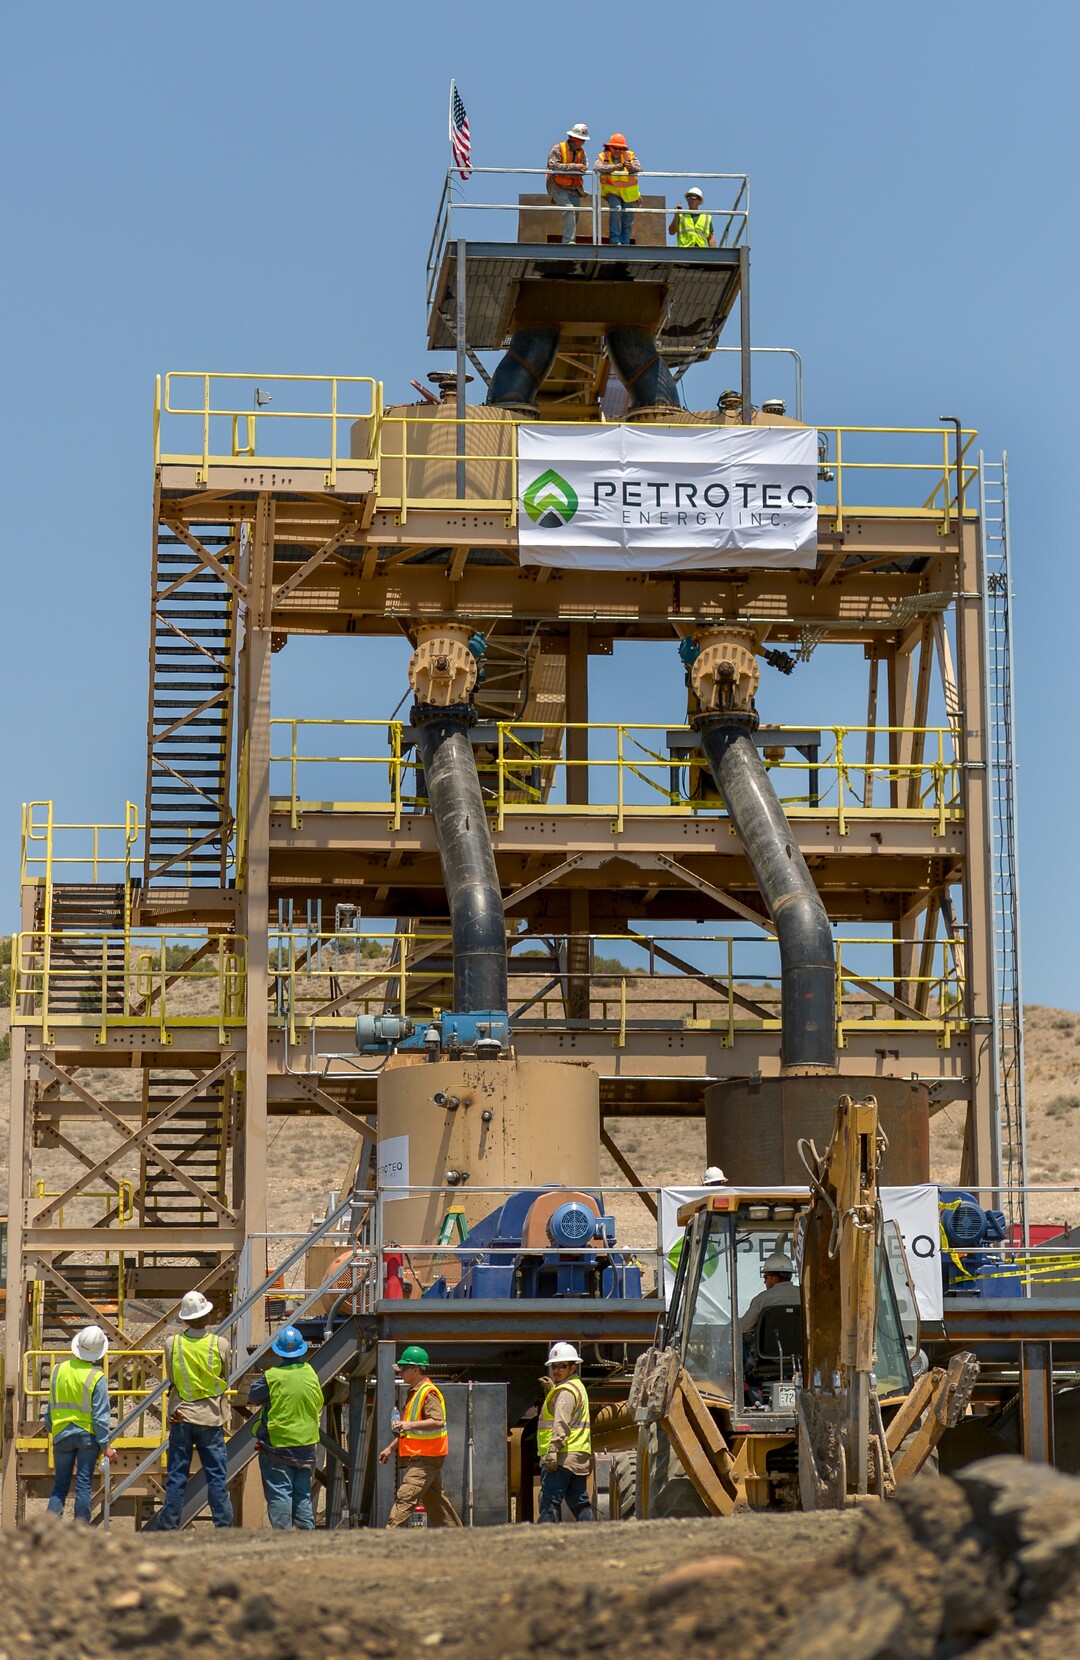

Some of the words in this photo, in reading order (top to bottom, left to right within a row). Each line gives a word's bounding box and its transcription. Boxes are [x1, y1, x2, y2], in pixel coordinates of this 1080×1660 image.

[593, 481, 813, 510] PETROTEQ
[622, 510, 724, 526] ENERGY
[738, 512, 787, 528] INC.
